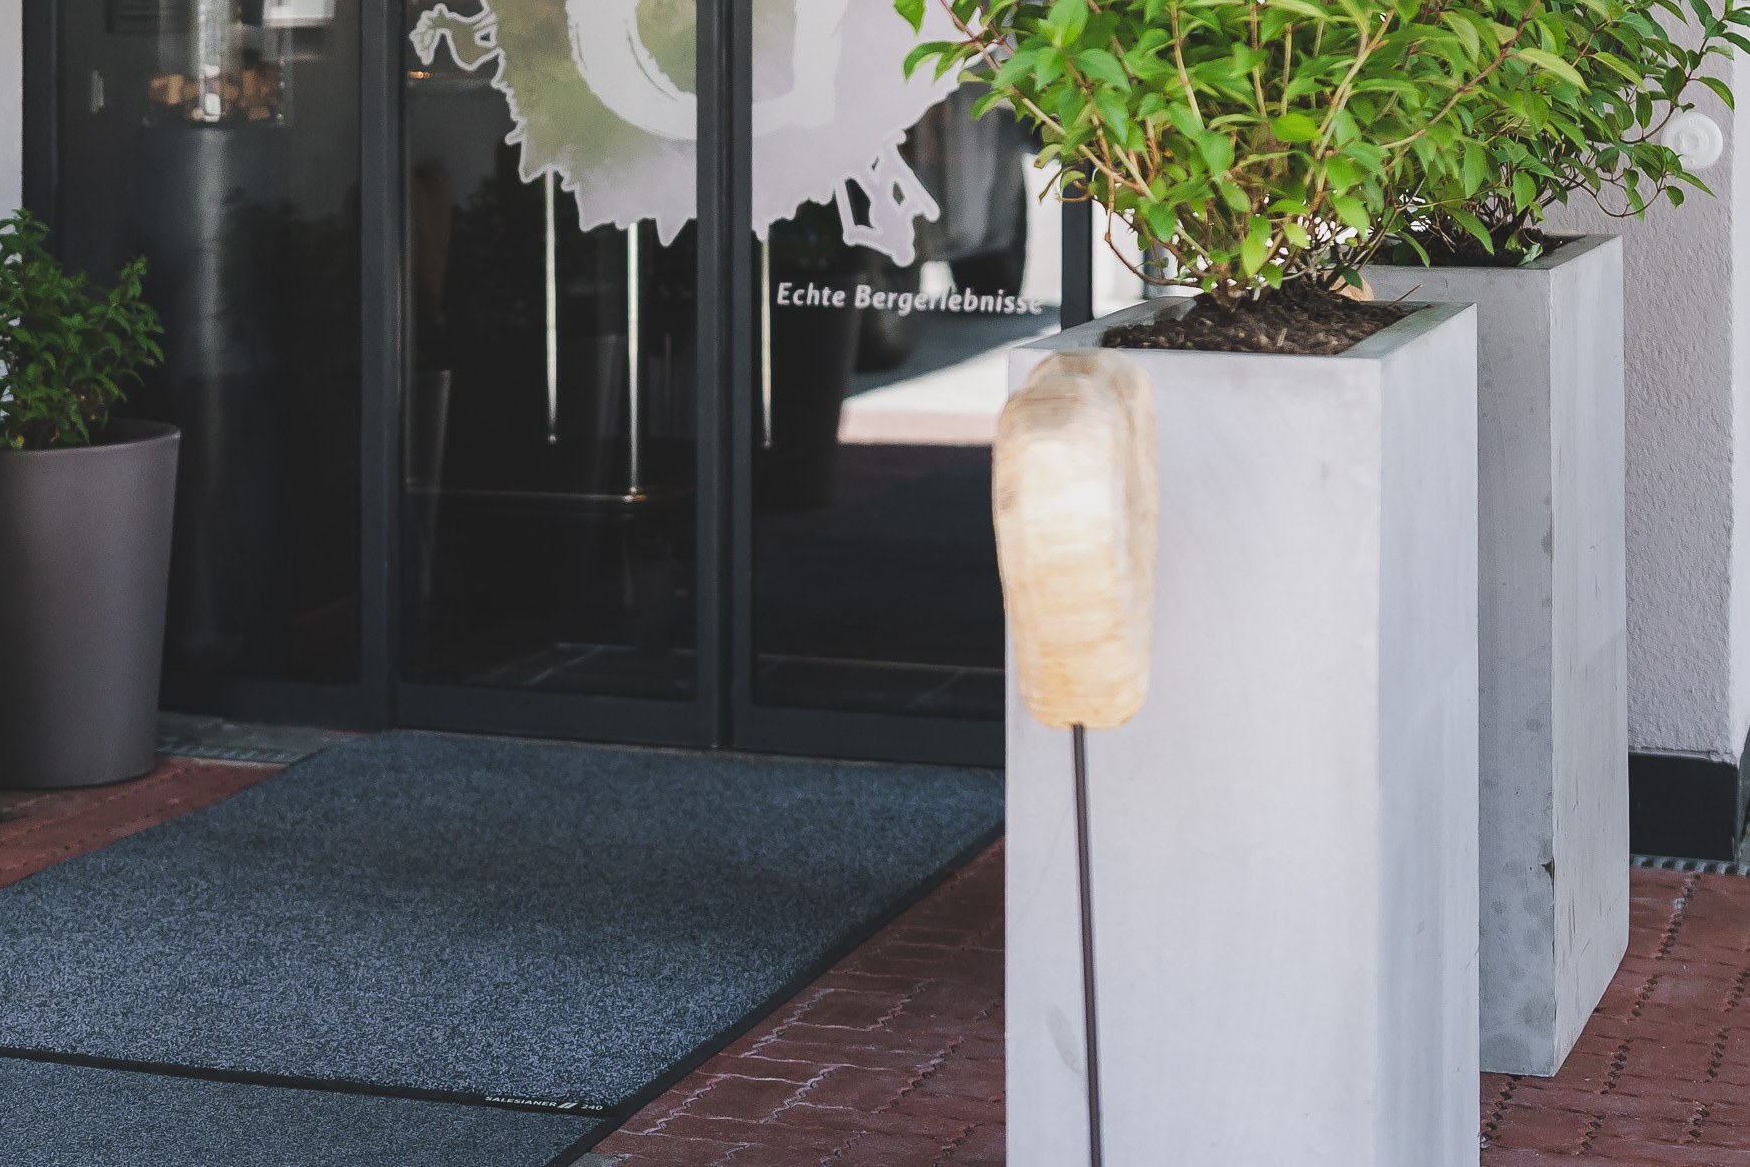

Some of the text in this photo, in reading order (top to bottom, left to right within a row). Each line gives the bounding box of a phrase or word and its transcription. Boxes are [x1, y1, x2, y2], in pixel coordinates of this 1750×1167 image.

[776, 282, 1043, 316] Echte Bergerlebnisse
[485, 1096, 557, 1107] SALESIANER
